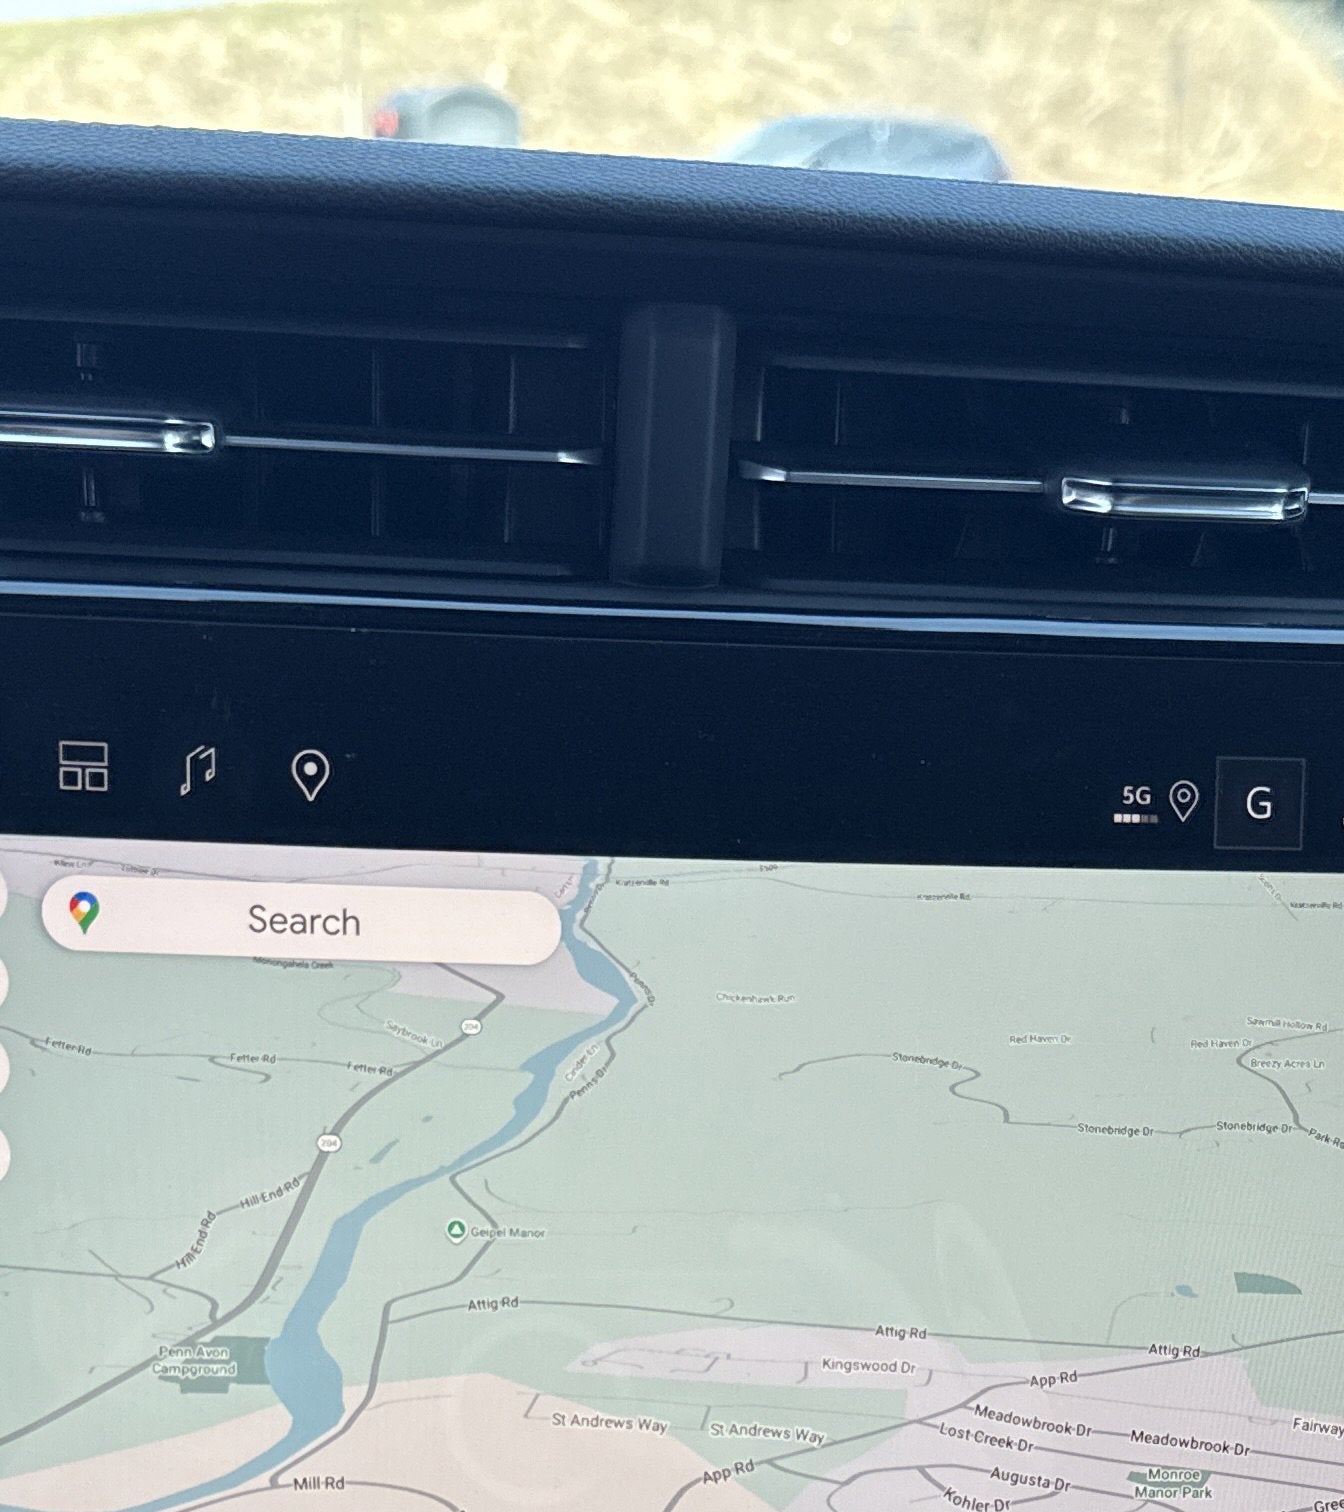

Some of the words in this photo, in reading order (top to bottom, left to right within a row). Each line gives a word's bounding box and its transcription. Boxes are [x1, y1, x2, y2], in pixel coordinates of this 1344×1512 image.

[1122, 786, 1151, 804] 5G
[1246, 787, 1272, 819] G
[249, 904, 361, 936] Search
[311, 960, 333, 969] Creek
[630, 971, 650, 996] Penns
[647, 993, 655, 1006] Dr
[778, 994, 795, 1002] Run
[1283, 1019, 1312, 1030] Hollow
[1315, 1022, 1327, 1032] Rd
[385, 1020, 427, 1045] Saybrook
[429, 1037, 444, 1048] Ln
[1010, 1035, 1027, 1044] Red
[1030, 1035, 1057, 1043] Haven
[1060, 1034, 1071, 1042] Dr
[46, 1037, 72, 1053] Fetter
[72, 1045, 91, 1056] Rd
[585, 1044, 599, 1059] Ln
[1191, 1040, 1208, 1048] Red
[1211, 1040, 1237, 1048] Haven
[1240, 1039, 1251, 1048] Dr
[230, 1053, 261, 1063] Fetter
[262, 1053, 276, 1063] Rd
[892, 1051, 950, 1069] Stonebridge
[951, 1060, 963, 1070] Dr
[1250, 1059, 1282, 1070] Breezy
[1313, 1059, 1325, 1069] Ln
[347, 1061, 377, 1074] Fetter
[378, 1066, 393, 1076] Rd
[570, 1075, 598, 1101] Penns
[595, 1066, 607, 1080] Dr
[1078, 1123, 1140, 1137] Stonebridge
[1142, 1126, 1154, 1136] Dr
[1216, 1120, 1279, 1134] Stonebridge
[1281, 1123, 1293, 1133] Dr
[1308, 1127, 1332, 1144] Park
[240, 1195, 260, 1210] Hill
[261, 1186, 282, 1203] End
[283, 1176, 300, 1193] Rd
[175, 1252, 195, 1270] Hill
[190, 1230, 208, 1254] End
[201, 1210, 217, 1231] Rd
[471, 1226, 506, 1240] Geipel
[509, 1227, 545, 1239] Manor
[467, 1297, 498, 1312] Attig
[501, 1296, 519, 1308] Rd
[875, 1325, 906, 1340] Attig
[908, 1328, 927, 1339] Rd
[159, 1347, 191, 1359] Penn
[196, 1347, 229, 1359] Avon
[1148, 1344, 1180, 1359] Attig
[1182, 1346, 1200, 1358] Rd
[152, 1363, 236, 1378] Campground
[822, 1358, 898, 1374] Kingswood
[901, 1362, 916, 1374] Dr
[1030, 1375, 1056, 1389] App
[1060, 1371, 1077, 1383] Rd
[552, 1412, 566, 1426] St
[570, 1414, 632, 1430] Andrews
[636, 1417, 668, 1435] Way
[974, 1403, 1073, 1433] Meadowbrook
[1075, 1424, 1092, 1437] Dr
[710, 1423, 724, 1436] St
[728, 1424, 790, 1440] Andrews
[794, 1428, 825, 1446] Way
[939, 1422, 972, 1440] Lost
[974, 1430, 1014, 1449] Creek
[1017, 1439, 1034, 1452] Dr
[1130, 1430, 1230, 1453] Meadowbrook
[1234, 1443, 1250, 1456] Dr
[702, 1466, 730, 1485] App
[734, 1459, 754, 1475] Rd
[990, 1467, 1052, 1489] Augusta
[1055, 1478, 1071, 1492] Dr
[1148, 1468, 1200, 1481] Monroe
[293, 1477, 320, 1491] Mill
[324, 1476, 345, 1490] Rd
[943, 1487, 992, 1511] Kohler
[994, 1499, 1011, 1512] Dr
[1135, 1487, 1179, 1499] Manor
[1182, 1486, 1212, 1499] Park
